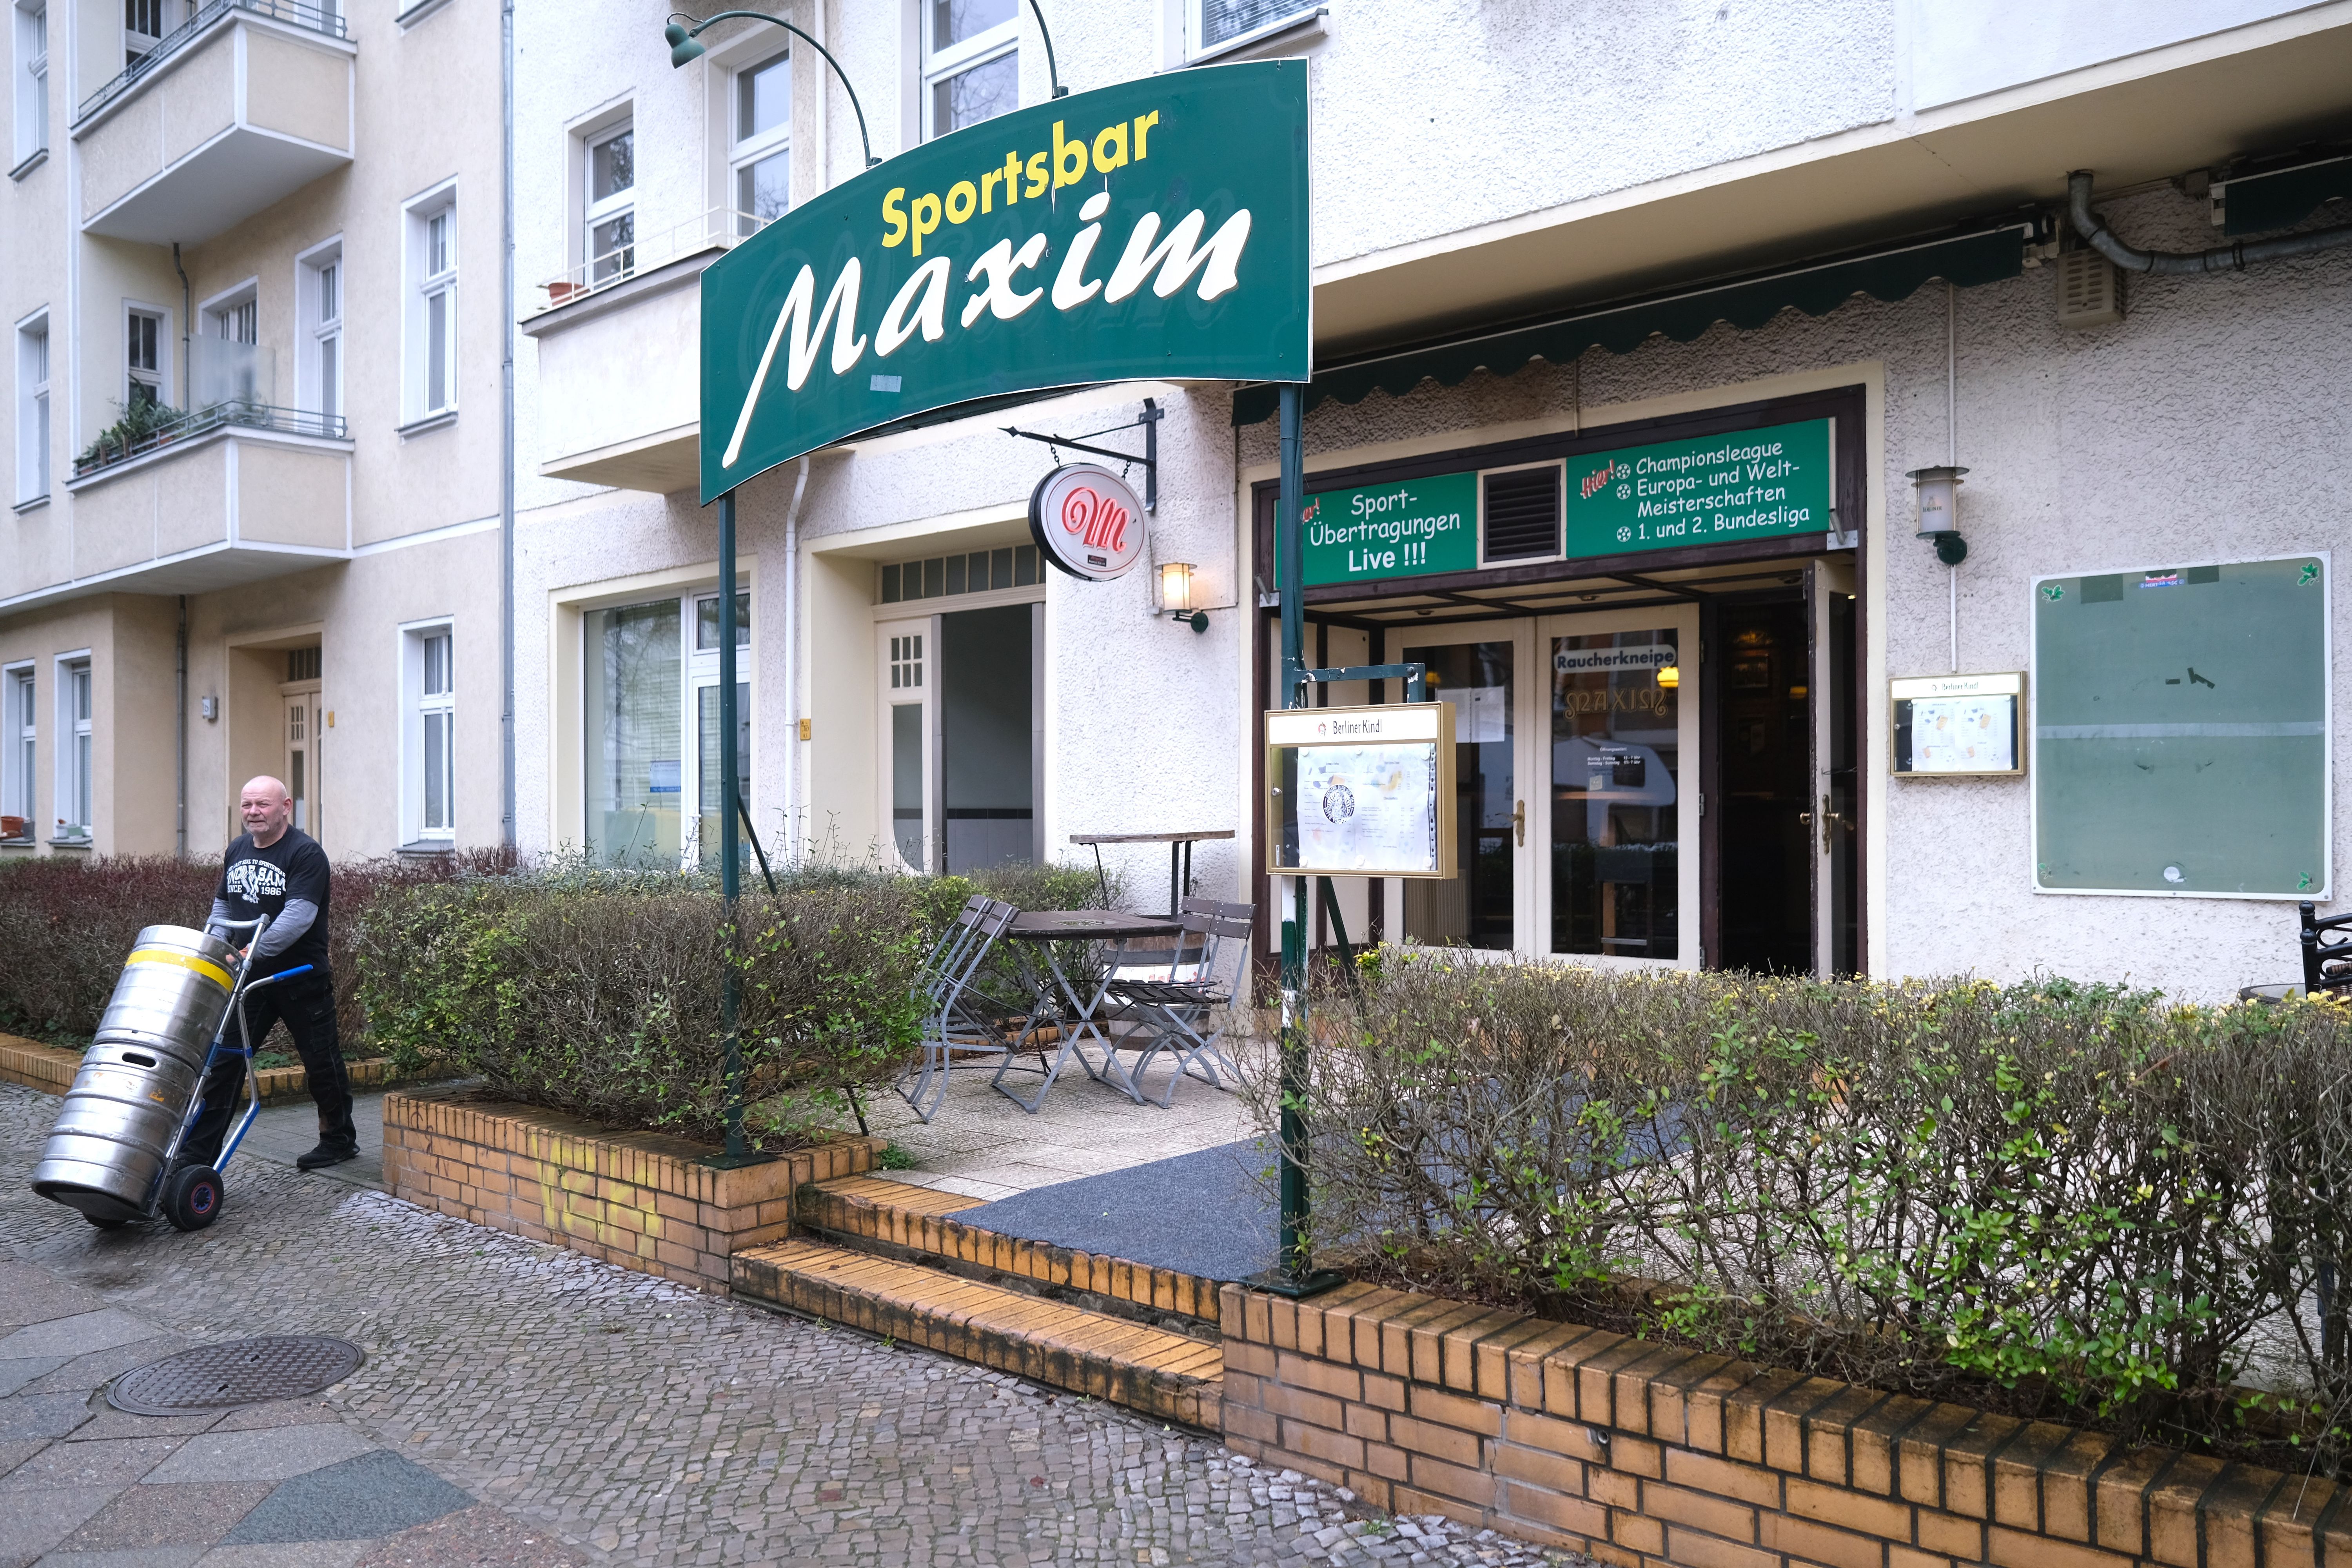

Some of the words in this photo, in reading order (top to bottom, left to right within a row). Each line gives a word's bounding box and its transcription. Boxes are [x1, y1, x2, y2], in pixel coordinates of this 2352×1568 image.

[882, 110, 1158, 257] Sportsbar
[722, 192, 1253, 469] Maxim
[1637, 443, 1782, 474] Championsleague
[1580, 459, 1615, 499] Hier!
[1637, 477, 1702, 497] Europa-
[1709, 465, 1739, 486] und
[1747, 459, 1800, 481] Welt-
[1302, 497, 1320, 525] er!
[1351, 489, 1417, 520] Sport-
[1638, 486, 1785, 518] Meisterschaften
[1310, 513, 1460, 546] Übertragungen
[1639, 523, 1650, 539] 1.
[1656, 518, 1685, 538] und
[1692, 517, 1707, 534] 2.
[1715, 506, 1809, 531] Bundesliga
[1349, 548, 1395, 572] Live
[1557, 649, 1674, 668] Raucherkneipe
[1333, 720, 1361, 735] Berliner
[1363, 719, 1382, 733] Kindl
[258, 860, 286, 878] SPORTSWEAR
[258, 867, 286, 892] SAM
[227, 884, 243, 893] SINCE
[261, 886, 282, 896] 1986
